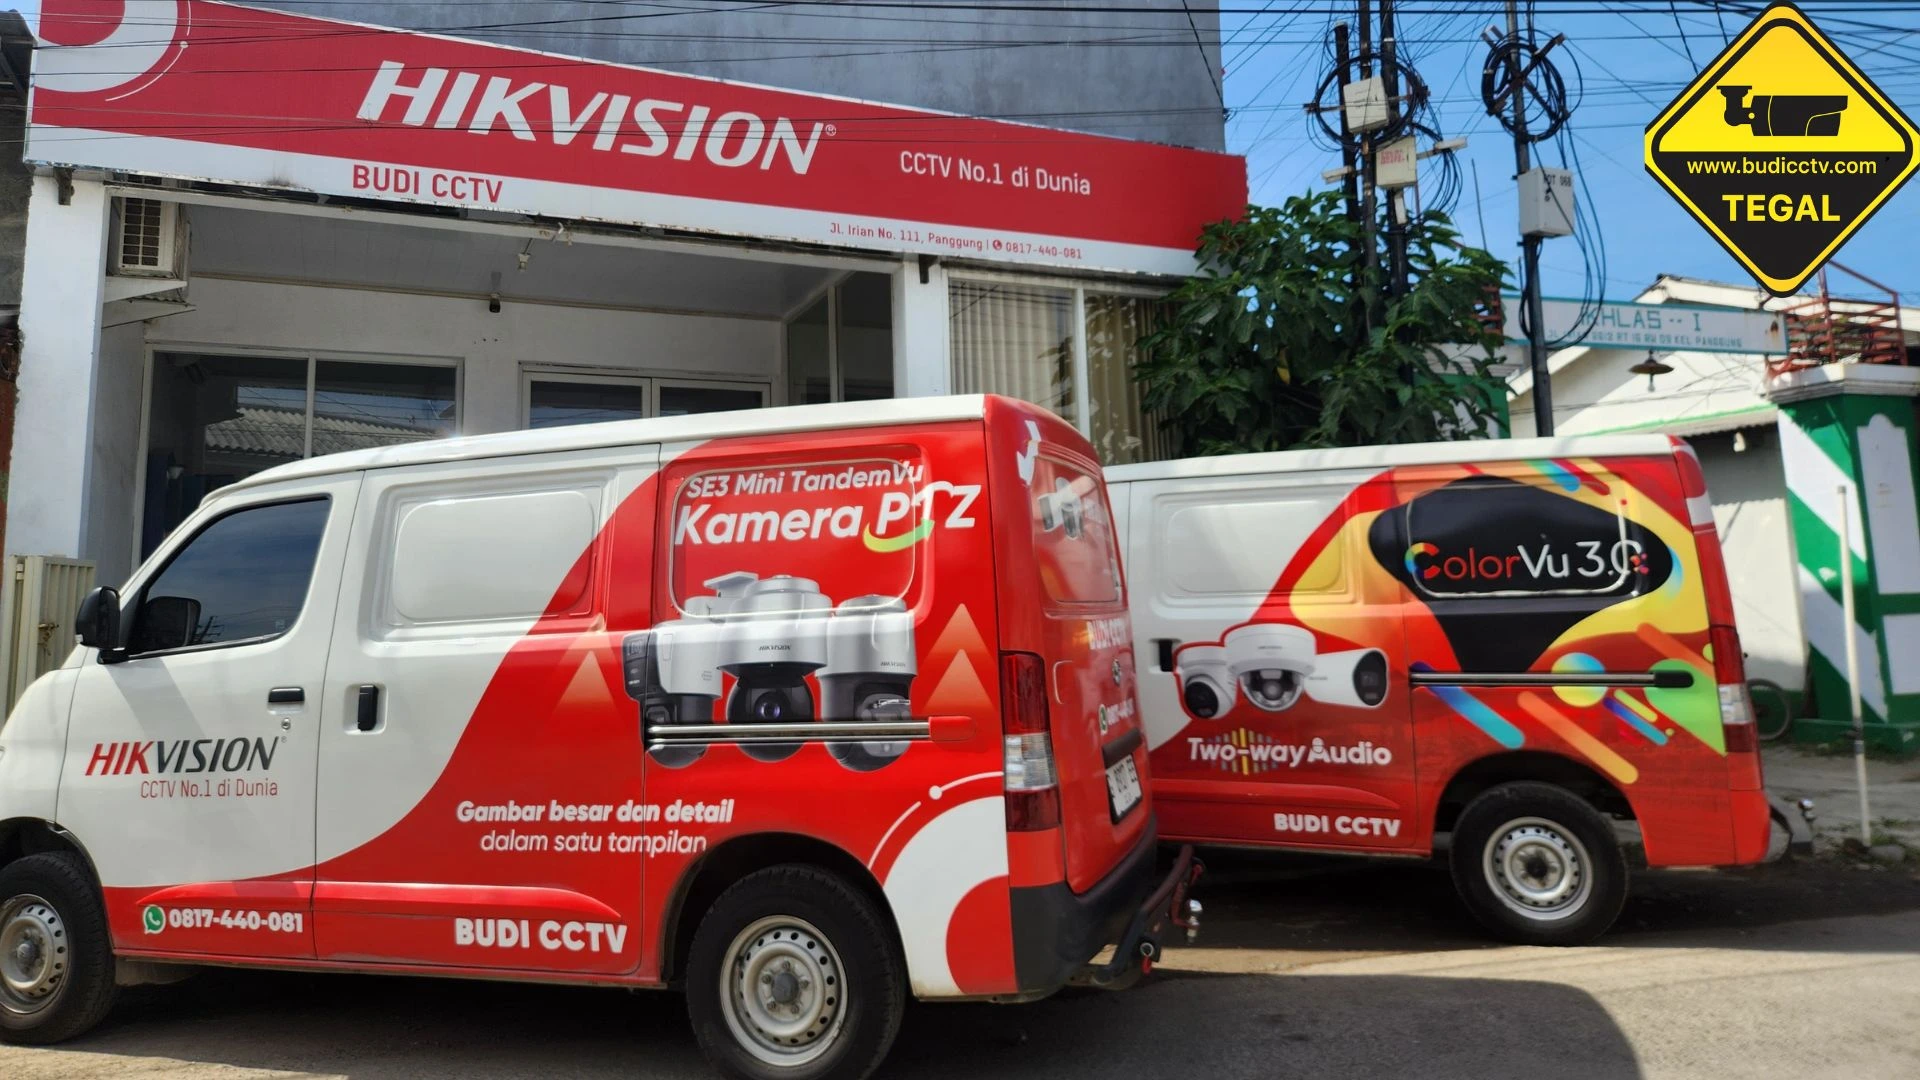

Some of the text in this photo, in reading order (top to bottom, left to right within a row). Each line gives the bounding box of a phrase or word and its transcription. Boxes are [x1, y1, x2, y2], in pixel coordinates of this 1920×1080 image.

[356, 60, 825, 175] HIKVISION
[352, 164, 503, 203] BUDI CCTV
[900, 151, 1091, 195] CCTV No.1 di Dunia
[830, 222, 844, 236] Jl.
[848, 224, 874, 237] Irian
[878, 227, 896, 240] No.
[928, 233, 983, 251] Panggung
[1005, 242, 1082, 259] 0817-440-081
[687, 460, 924, 498] SE3 Mini TandemVu
[674, 503, 863, 545] Kamera
[1405, 541, 1570, 579] ColorVu
[85, 736, 279, 776] HIKVISION
[1187, 737, 1392, 768] Two-way Audio
[140, 778, 278, 798] CCTV No.1 di Dunia
[456, 799, 735, 823] Gambar besar dan detail
[1274, 812, 1401, 837] BUDI CCTV
[480, 829, 707, 858] dalam satu tampilan
[168, 908, 303, 933] 0817-440-081
[455, 917, 627, 954] BUDI CCTV
